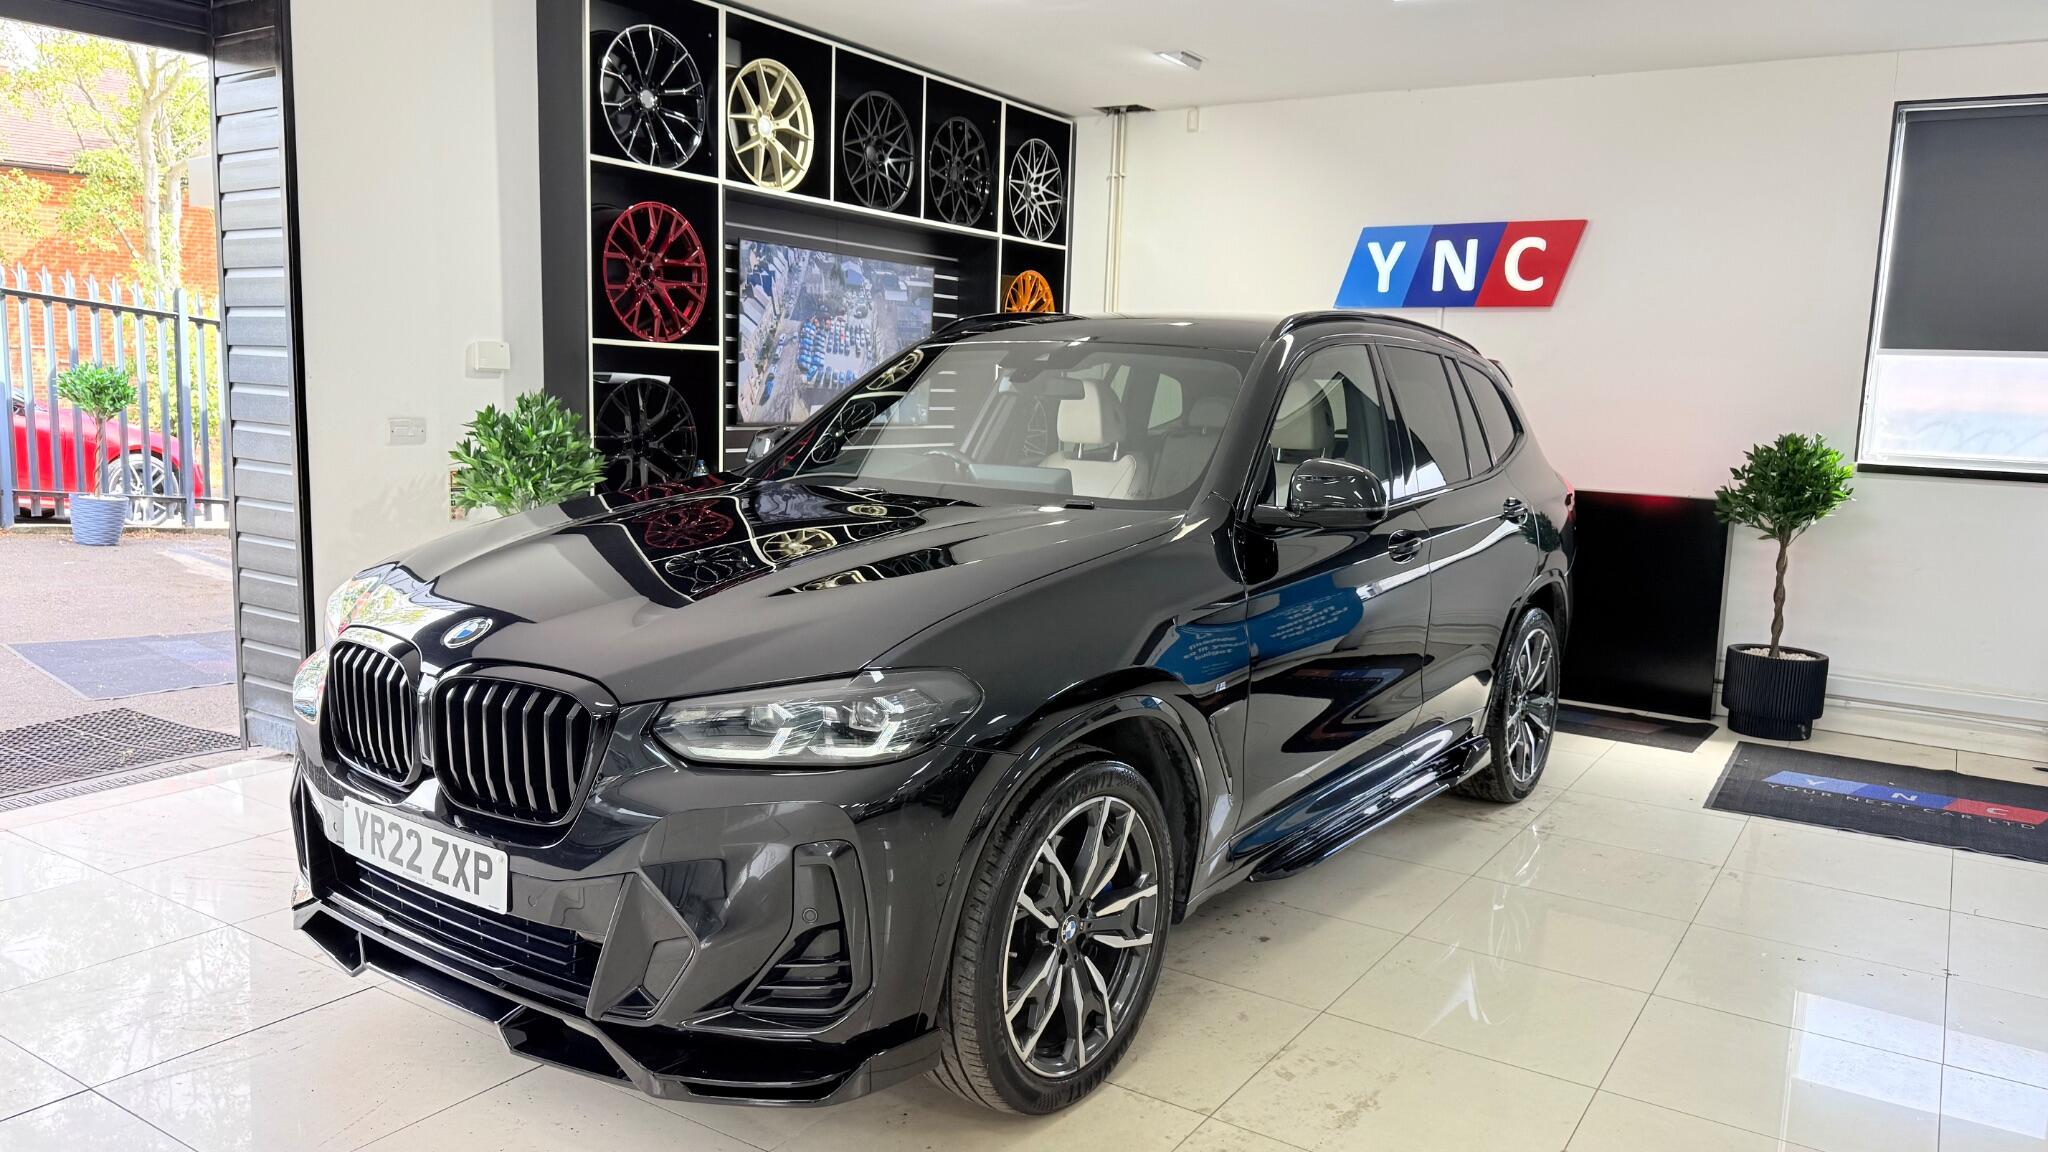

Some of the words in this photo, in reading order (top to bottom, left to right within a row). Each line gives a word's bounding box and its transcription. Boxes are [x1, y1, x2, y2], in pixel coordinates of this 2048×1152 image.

[1368, 237, 1547, 292] YNC
[1768, 783, 1832, 797] YOUR
[1846, 796, 1910, 808] NEXT
[1923, 808, 1975, 820] CAR
[1988, 818, 2036, 830] LTD
[355, 807, 422, 875] YR22
[432, 837, 492, 895] ZXP
